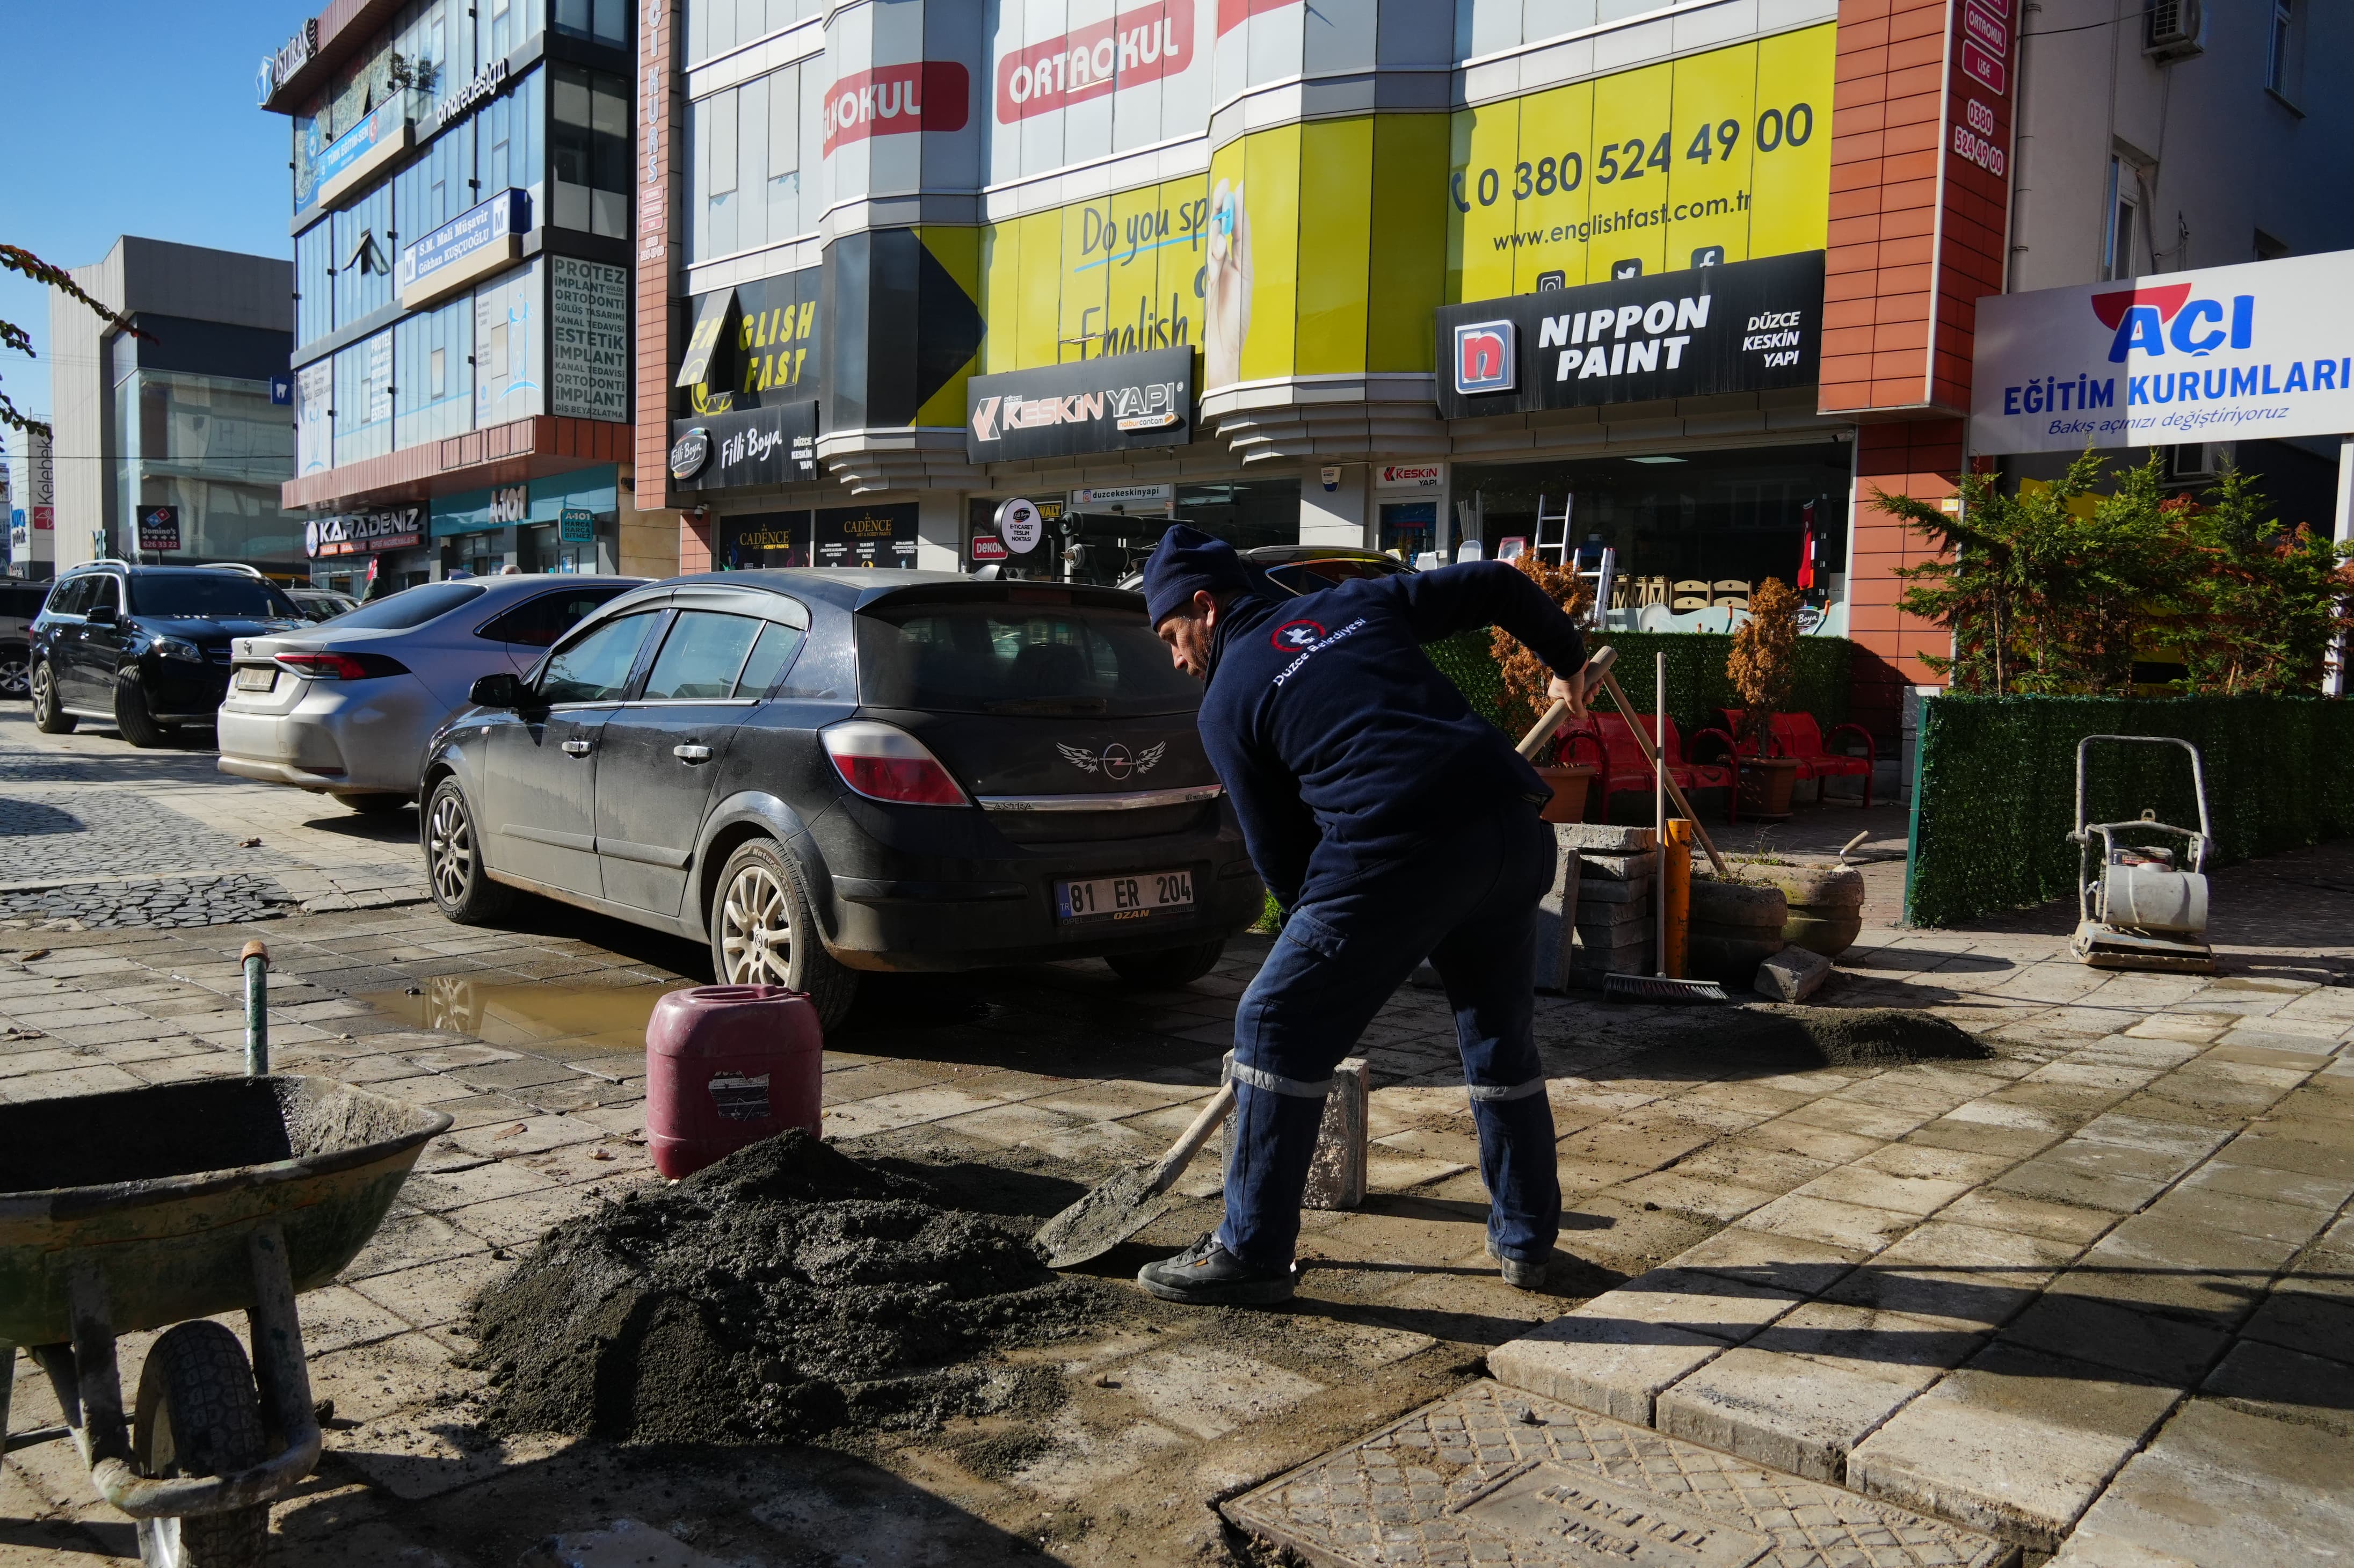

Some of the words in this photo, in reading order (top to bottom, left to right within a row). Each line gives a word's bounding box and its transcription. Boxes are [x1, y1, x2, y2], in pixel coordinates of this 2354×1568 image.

[1969, 11, 2002, 47] ORTAOKUL
[1009, 18, 1178, 104] ORTAOKUL
[1978, 57, 1990, 78] LİSE
[437, 58, 506, 125] onoredesign
[648, 66, 660, 183] KURS
[1968, 99, 1993, 136] 0380
[1478, 168, 1499, 207] 0
[1512, 153, 1582, 200] 380
[1596, 132, 1670, 185] 524
[1687, 119, 1740, 164] 49
[1756, 103, 1813, 153] 00
[1955, 126, 1975, 161] 524
[1975, 139, 1989, 169] 49
[1989, 147, 2003, 176] 00
[1493, 191, 1750, 251] www.englishfast.com.tr
[419, 238, 435, 256] S.M.
[437, 227, 453, 247] Mali
[454, 209, 489, 237] Müşavir
[1082, 208, 1116, 255] Do
[1121, 209, 1168, 266] you
[419, 256, 442, 274] Gökhan
[554, 259, 624, 284] PROTEZ
[555, 276, 605, 294] İMPLANT
[555, 289, 624, 310] ORTODONTİ
[555, 303, 583, 315] GÜLÜŞ
[585, 308, 624, 321] TASARIMI
[1539, 295, 1711, 349] NIPPON
[1747, 311, 1800, 332] DÜZCE
[555, 315, 584, 327] KANAL
[587, 320, 624, 333] TEDAVİSİ
[2108, 295, 2254, 363] AÇI
[371, 331, 391, 353] PROTEZ
[555, 326, 624, 351] ESTETİK
[1742, 329, 1799, 351] KESKİN
[555, 344, 624, 367] İMPLANT
[1557, 336, 1690, 381] PAINT
[1763, 351, 1799, 368] YAPI
[555, 362, 585, 372] KANAL
[587, 366, 625, 378] TEDAVİSİ
[743, 348, 807, 394] FAST
[555, 373, 625, 391] ORTODONTİ
[2003, 373, 2115, 415] EĞİTİM
[2127, 357, 2351, 405] KURUMLARI
[556, 386, 624, 407] İMPLANT
[1003, 392, 1104, 430] KESKİN
[1106, 383, 1174, 417] YAPI
[556, 404, 569, 413] DİŞ
[571, 406, 623, 418] BEYAZLATMA
[2048, 420, 2095, 435] Bakış
[2099, 418, 2156, 434] açınızı
[2161, 407, 2289, 430] değiştiriyoruz
[722, 432, 745, 469] Filli
[747, 428, 782, 461] Boya
[793, 436, 812, 447] DÜZCE
[671, 444, 683, 466] Filli
[684, 442, 702, 460] Boya
[791, 449, 812, 460] KESKİN
[37, 439, 54, 505] Kelebek
[800, 461, 812, 470] YAPI
[1396, 468, 1437, 479] KESKİN
[1093, 487, 1159, 499] duzcekeskinyapi
[1038, 505, 1060, 517] WALT
[844, 519, 892, 533] CADENCE
[740, 531, 790, 545] CADENCE
[1798, 614, 1818, 625] Boya
[1307, 616, 1367, 652] Belediyesi
[994, 802, 1034, 810] ASTRA
[1071, 883, 1095, 912] 81
[1114, 879, 1140, 908] ER
[1157, 874, 1191, 903] 204
[1060, 903, 1070, 911] TR
[1113, 909, 1150, 920] OZAN
